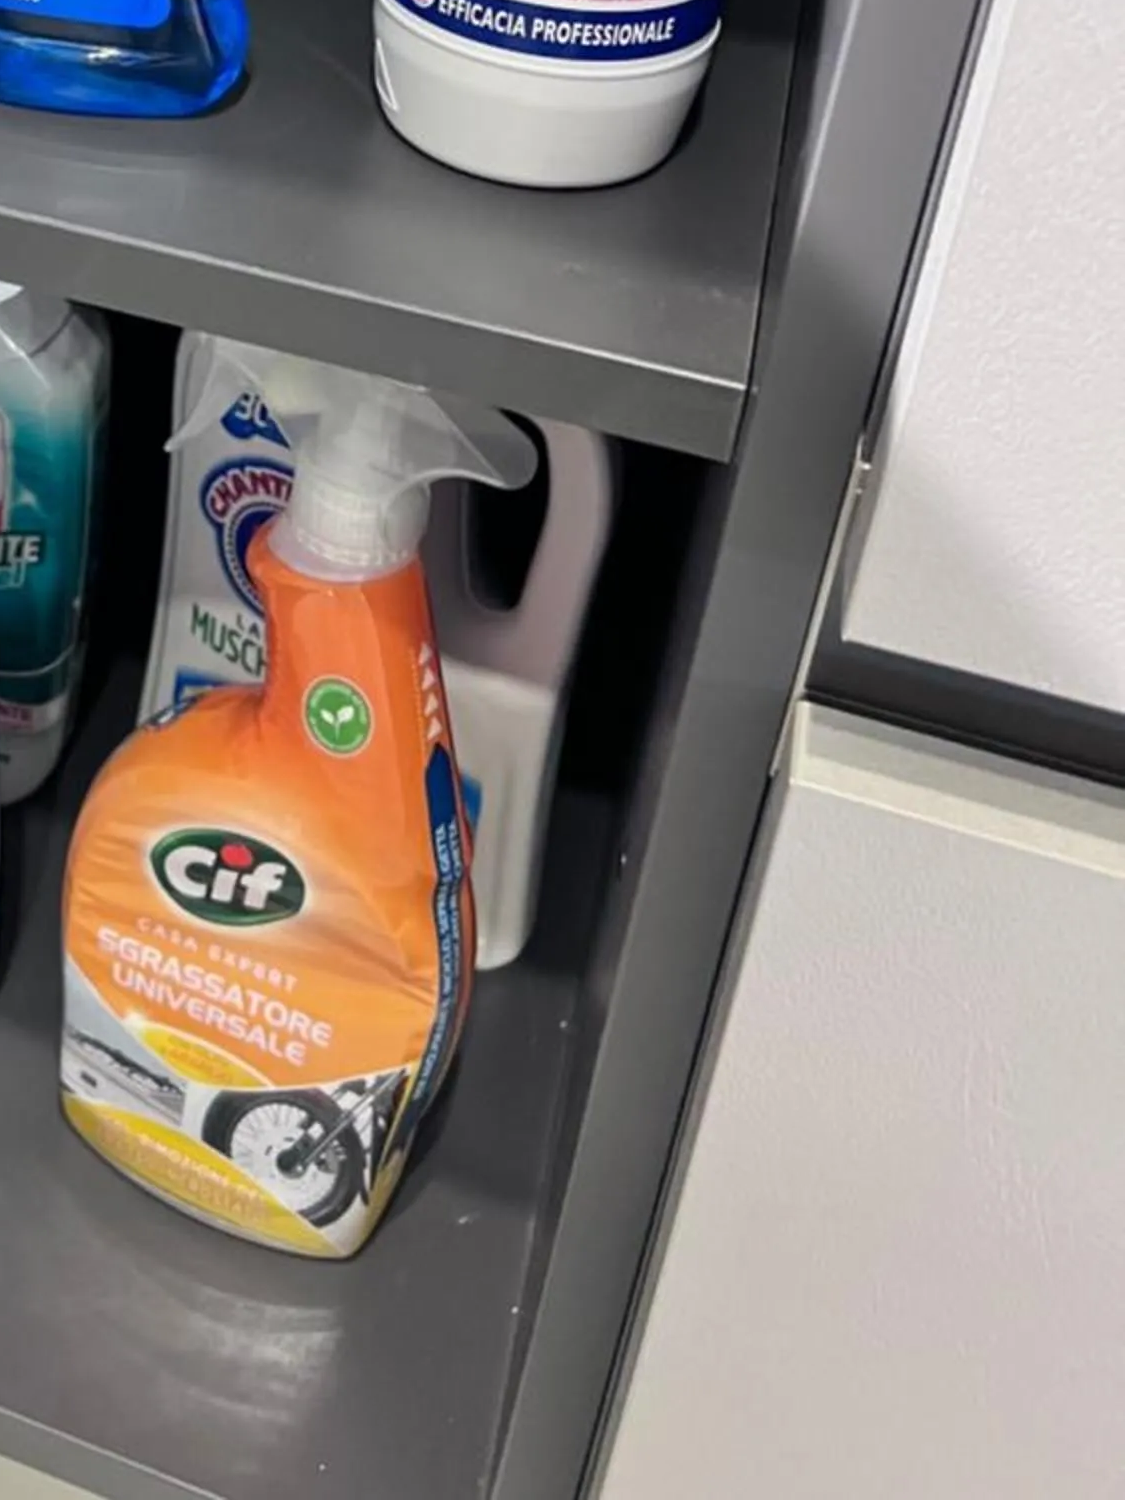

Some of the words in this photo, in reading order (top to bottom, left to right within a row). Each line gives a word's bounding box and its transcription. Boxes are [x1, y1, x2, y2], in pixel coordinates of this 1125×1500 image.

[531, 15, 675, 48] PROFESSIONALE
[163, 841, 287, 911] Cif
[96, 927, 334, 1048] SGRASSATORE
[135, 917, 198, 953] CASA
[207, 944, 298, 994] EXPERT
[112, 963, 307, 1067] UNIVERSALE
